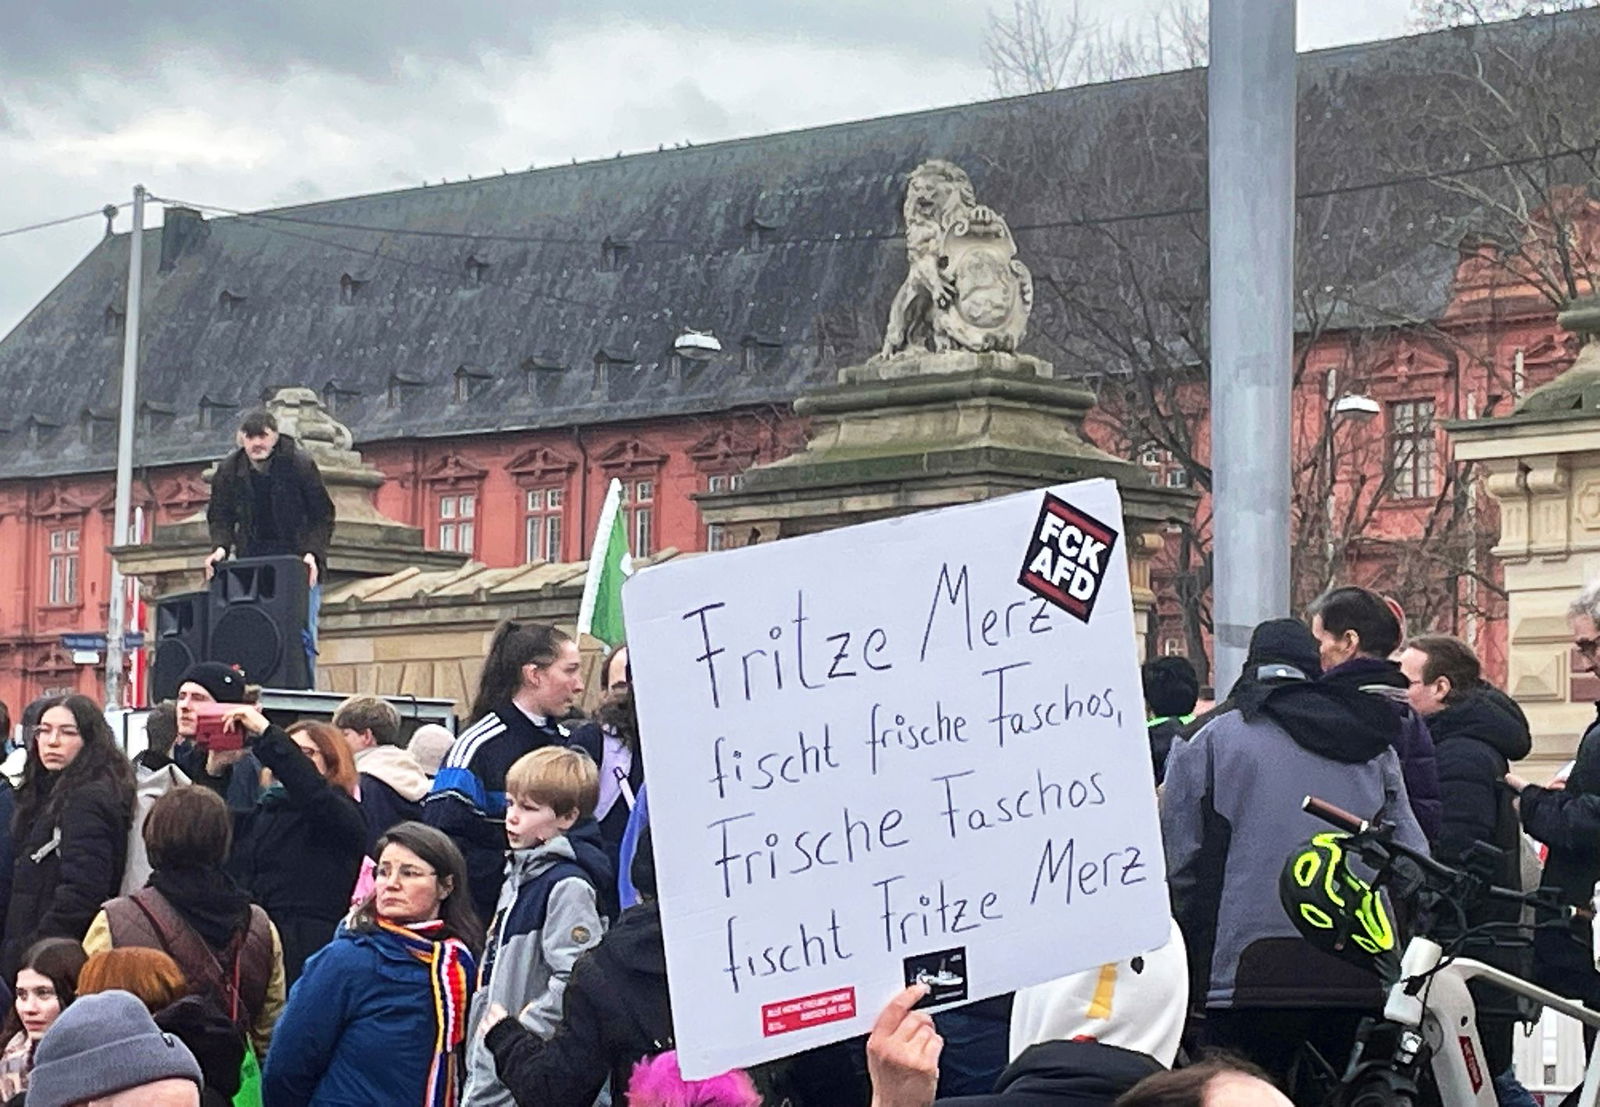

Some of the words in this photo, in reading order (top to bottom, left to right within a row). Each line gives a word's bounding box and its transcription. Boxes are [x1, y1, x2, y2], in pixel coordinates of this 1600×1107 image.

[1029, 546, 1095, 600] AFD
[1040, 511, 1107, 574] FCK
[682, 590, 892, 708] Fritze
[921, 563, 1052, 661] Merz
[709, 725, 839, 798] fischt
[866, 701, 968, 775] frische
[982, 662, 1121, 748] Faschos,
[707, 808, 909, 898] Frische
[932, 769, 1105, 838] Faschos
[723, 910, 852, 993] fischt
[873, 876, 1003, 952] Fritze
[1031, 839, 1146, 904] Merz
